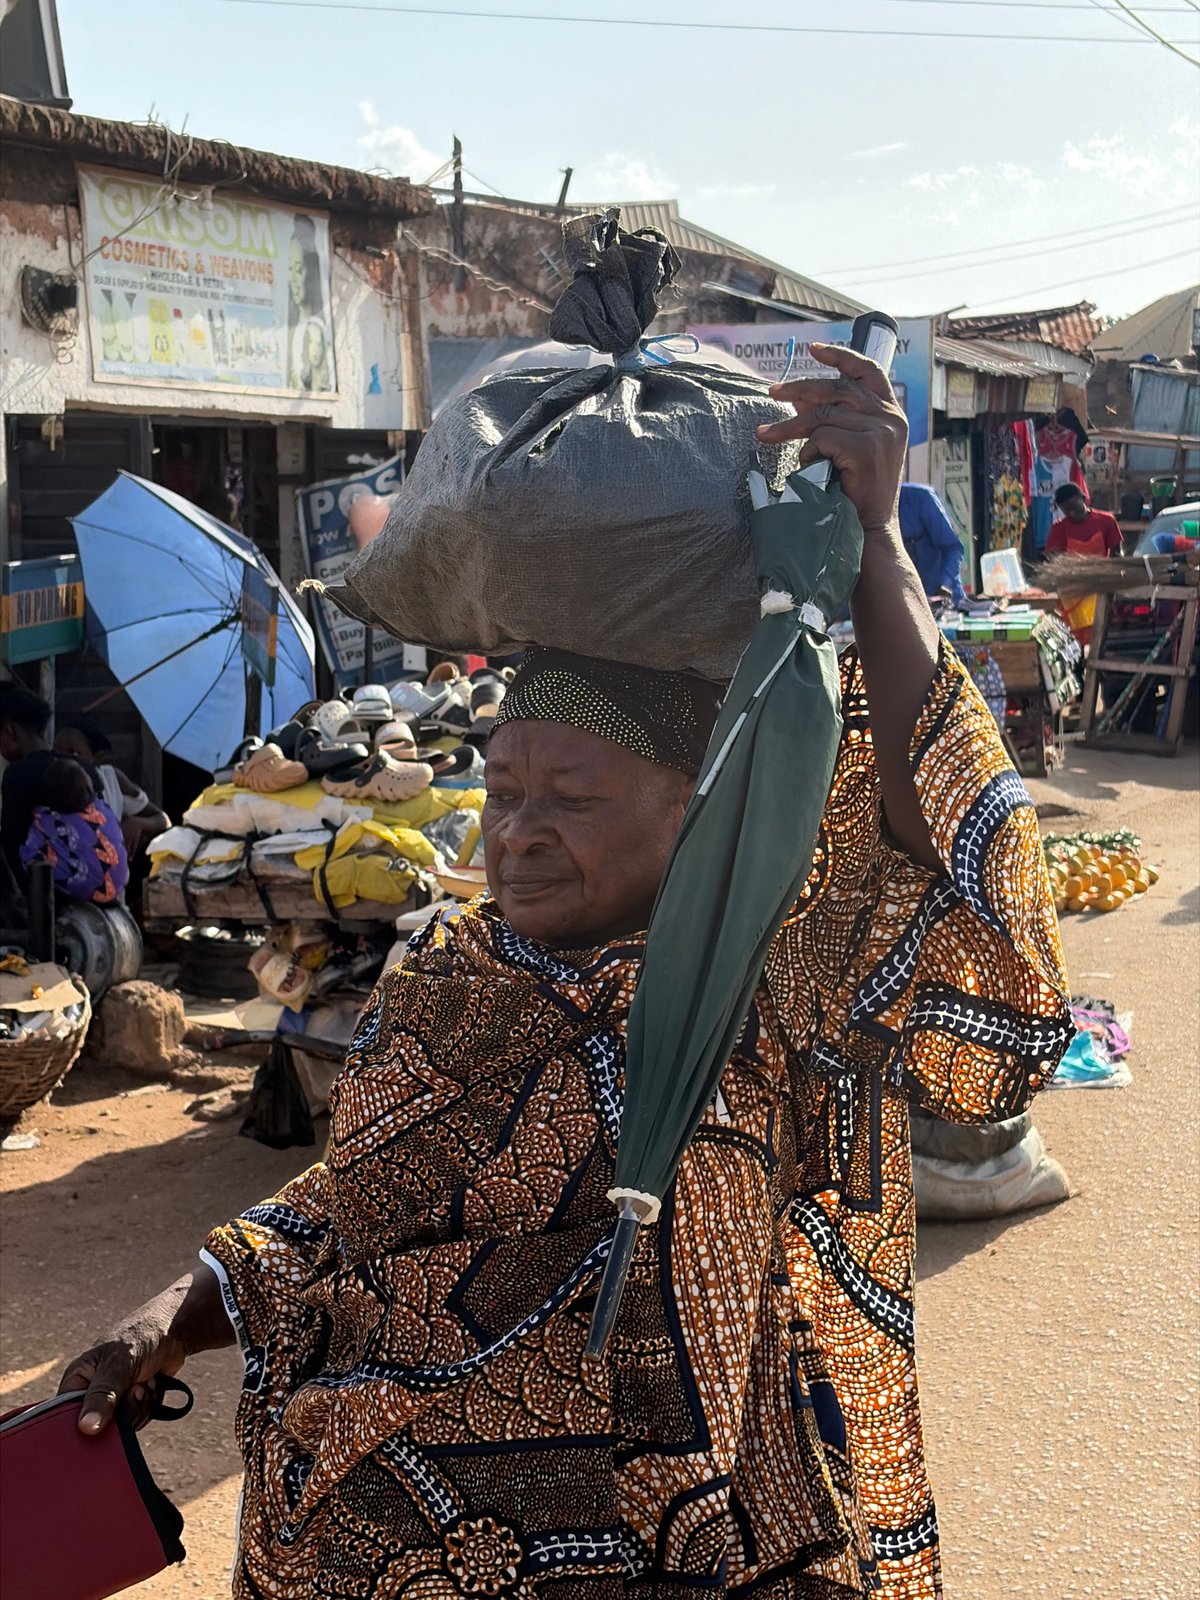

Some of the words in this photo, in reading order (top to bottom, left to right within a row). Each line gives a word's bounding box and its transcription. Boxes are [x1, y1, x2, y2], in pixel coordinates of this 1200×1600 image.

[100, 235, 190, 272] COSMETICS
[194, 253, 204, 274] &
[209, 253, 274, 285] WEAVONS
[17, 591, 32, 625] NO
[34, 585, 78, 623] PARKING
[339, 627, 364, 641] Buy
[346, 649, 365, 661] Pa
